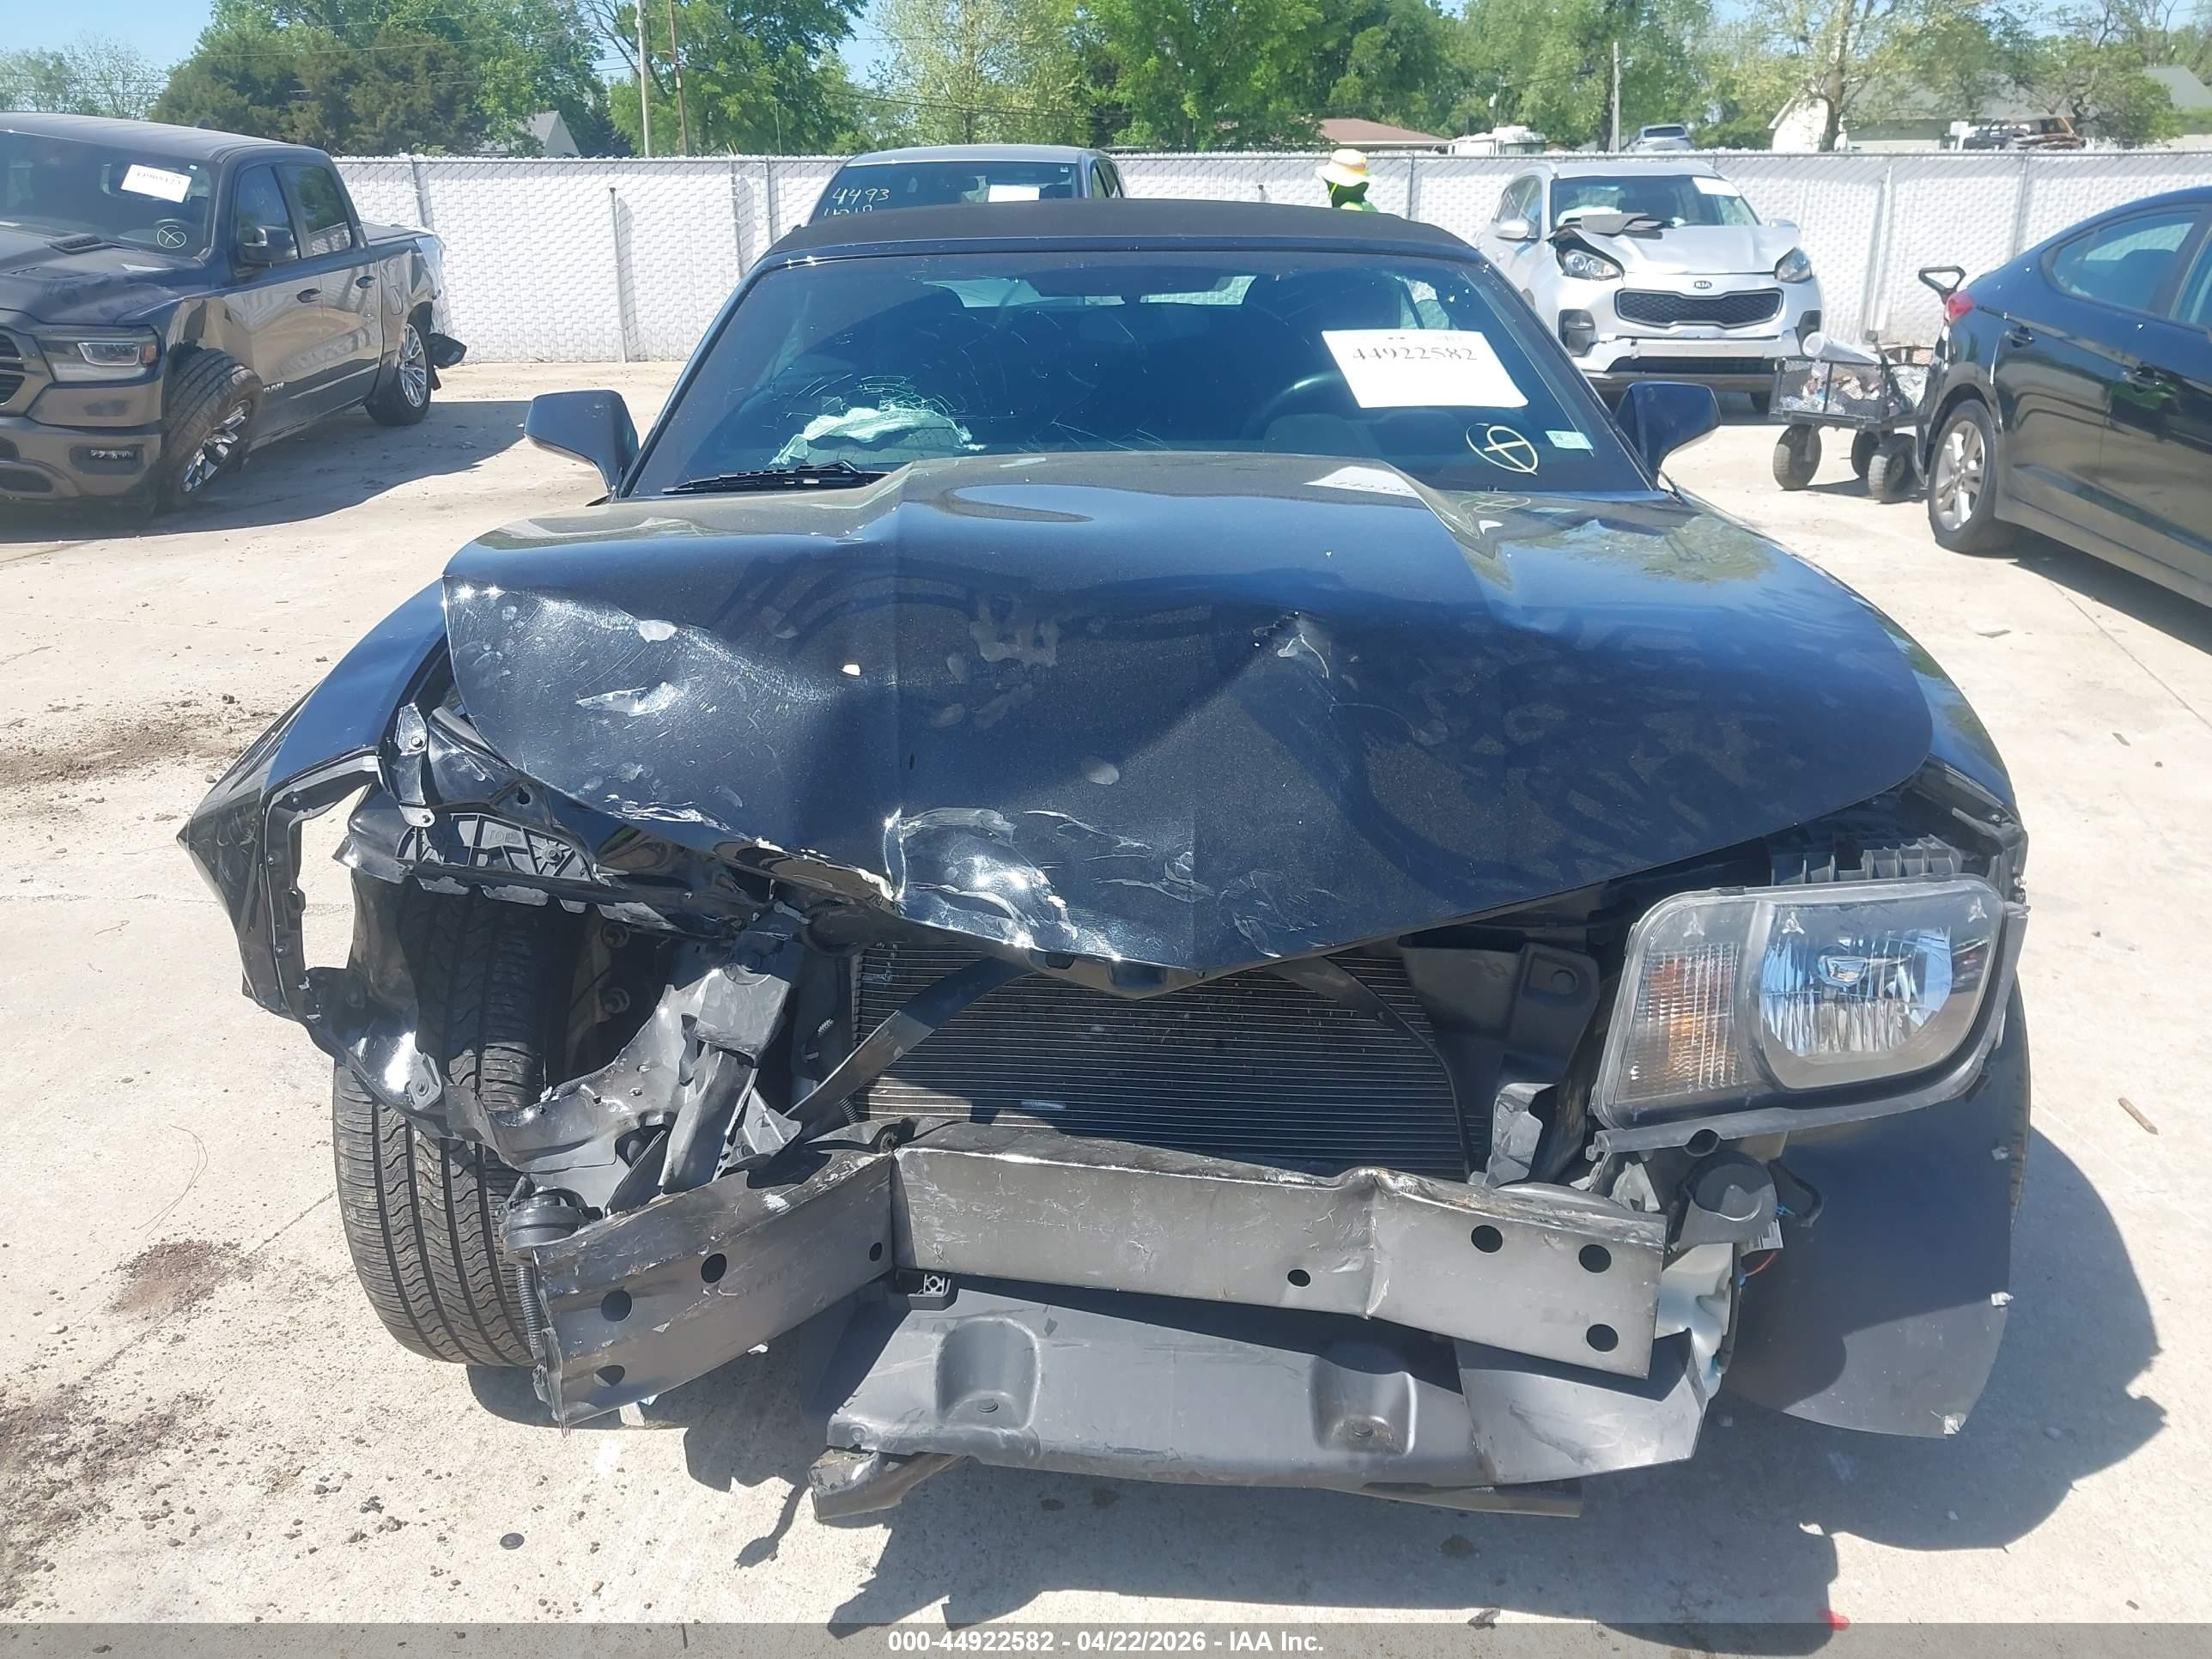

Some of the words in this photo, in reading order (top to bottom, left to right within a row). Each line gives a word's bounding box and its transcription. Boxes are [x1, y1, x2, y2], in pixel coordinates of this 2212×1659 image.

[832, 187, 890, 205] 4493
[1352, 347, 1478, 360] 44922582
[263, 381, 284, 392] RAM
